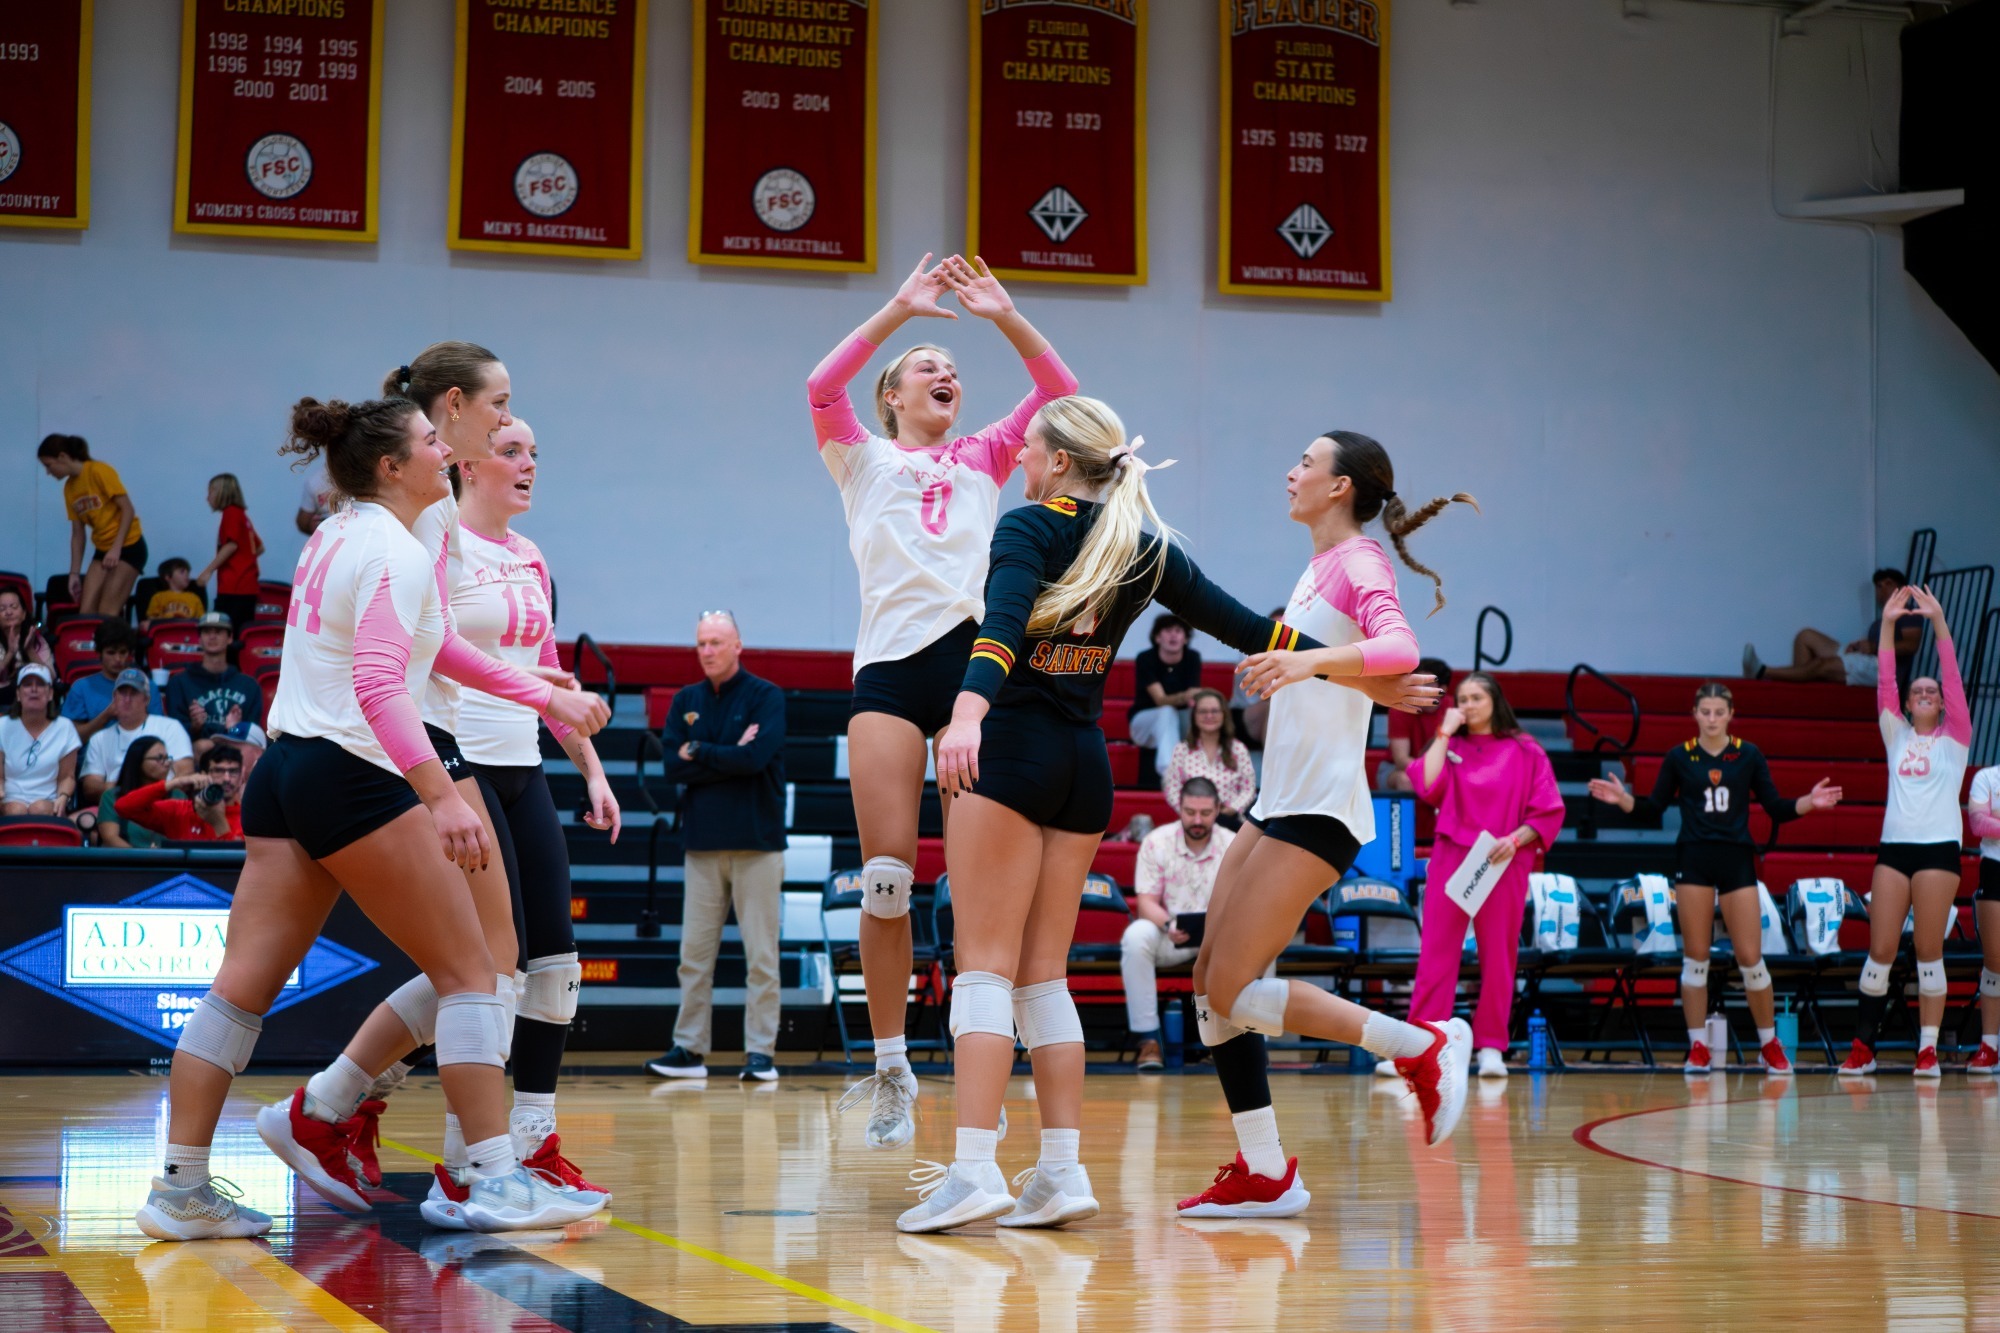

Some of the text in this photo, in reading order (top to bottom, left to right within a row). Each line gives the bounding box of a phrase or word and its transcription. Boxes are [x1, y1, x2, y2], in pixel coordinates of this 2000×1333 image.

[224, 0, 345, 18] CHAMPIONS
[722, 0, 850, 21] CONFERENCE
[494, 12, 610, 38] CHAMPIONS
[718, 17, 855, 45] TOURNAMENT
[1028, 19, 1090, 37] FLORIDA
[208, 32, 358, 57] 1992 1994 1995
[729, 42, 842, 68] CHAMPIONS
[1026, 39, 1090, 60] STATE
[1275, 40, 1334, 58] FLORIDA
[208, 55, 358, 80] 1996 1997 1999
[1003, 61, 1111, 85] CHAMPIONS
[1275, 60, 1335, 81] STATE
[234, 79, 329, 101] 2000 2001
[504, 76, 596, 98] 2004 2005
[1253, 81, 1356, 106] CHAMPIONS
[741, 90, 830, 112] 2003 2004
[1016, 110, 1102, 130] 1972 1973
[1241, 129, 1368, 152] 1975 1976 1977
[262, 156, 300, 178] FSC
[1289, 156, 1324, 173] 1979
[529, 176, 567, 197] FSC
[767, 190, 803, 212] FSC
[195, 203, 359, 224] WOMEN'S CROSS COUNTRY
[483, 220, 607, 242] MEN'S BASKETBALL
[723, 236, 843, 255] MEN'S BASKETBALL
[1021, 251, 1095, 267] VOLLEYBALL
[1241, 265, 1368, 285] WOMEN'S BASKETBALL
[920, 478, 953, 536] 0
[286, 528, 345, 636] 24
[500, 584, 548, 647] 16
[1029, 640, 1111, 675] SAINTS
[1703, 786, 1730, 812] 10
[1391, 803, 1401, 869] POWERADE
[1341, 884, 1400, 904] FLAGLER
[84, 921, 153, 948] A.D.
[157, 993, 200, 1009] Sinc
